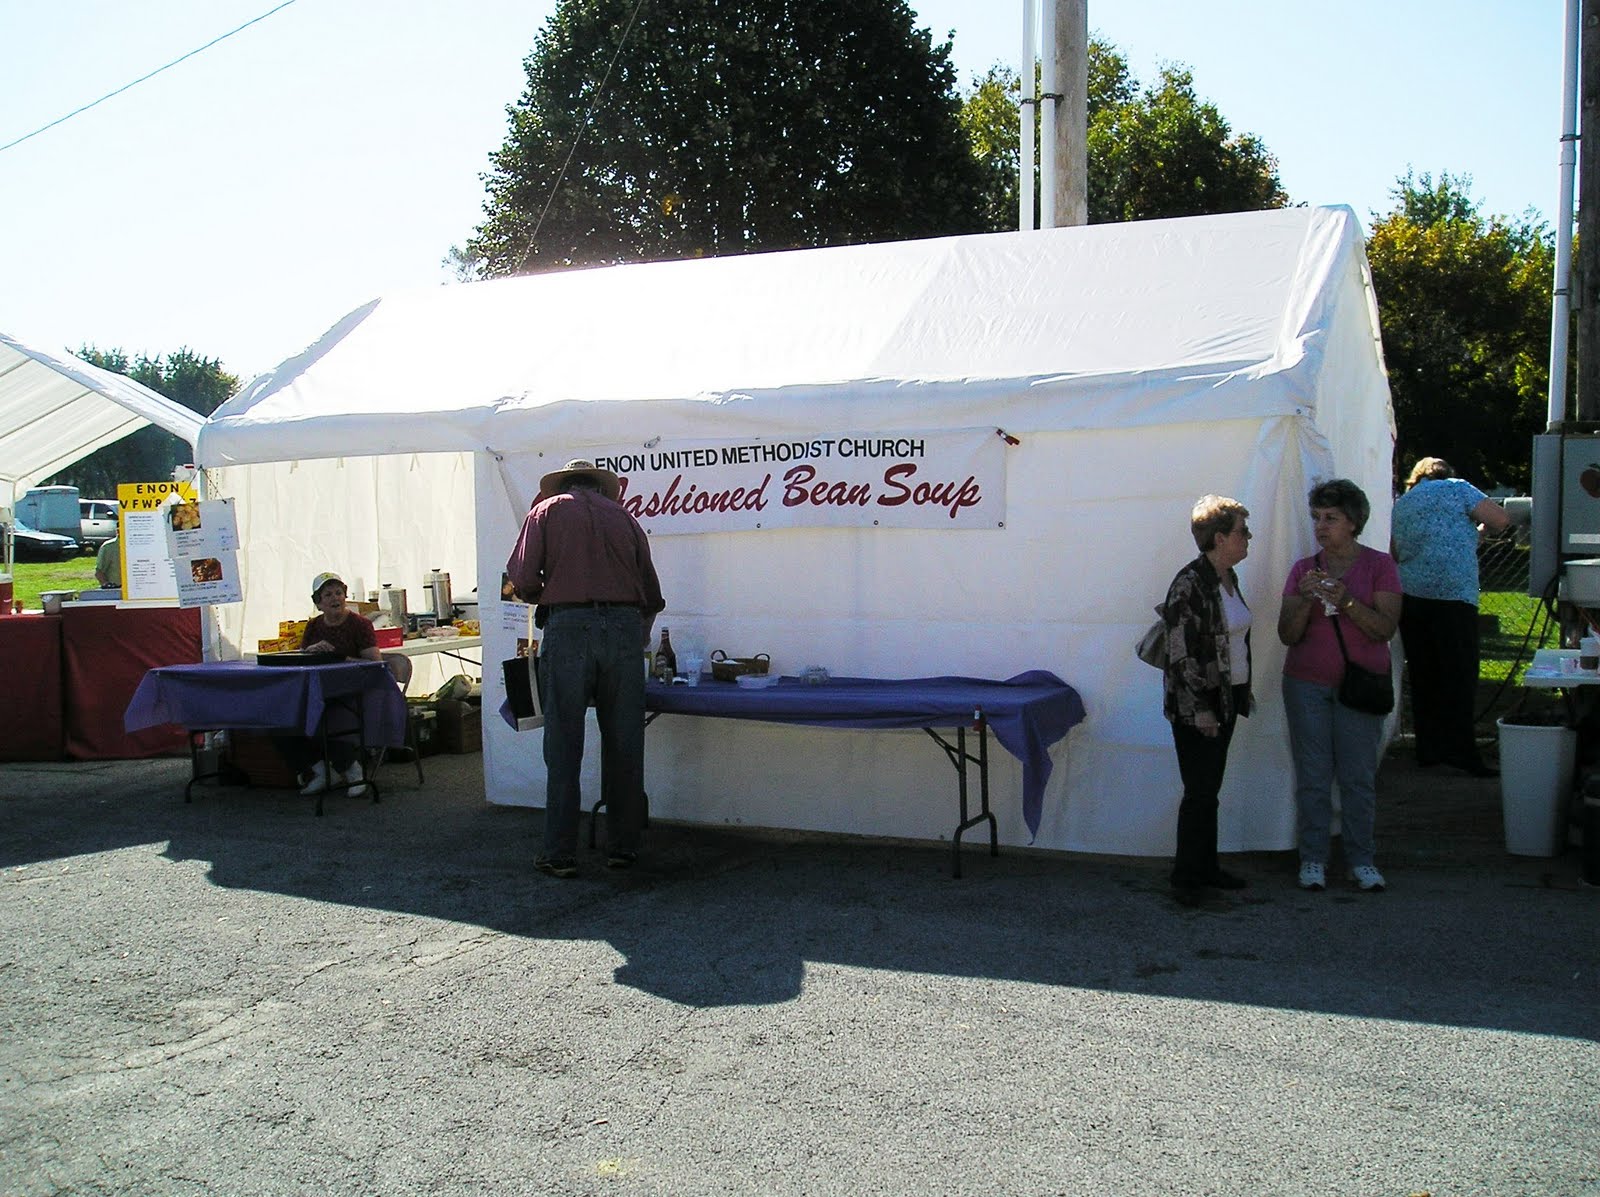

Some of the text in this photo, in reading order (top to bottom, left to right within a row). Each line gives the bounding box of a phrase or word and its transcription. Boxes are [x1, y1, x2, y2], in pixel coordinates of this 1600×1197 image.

[595, 438, 925, 473] ENON UNITED METHODIST CHURCH
[137, 484, 179, 494] ENON
[782, 464, 872, 507] Bean
[877, 463, 982, 519] Soup
